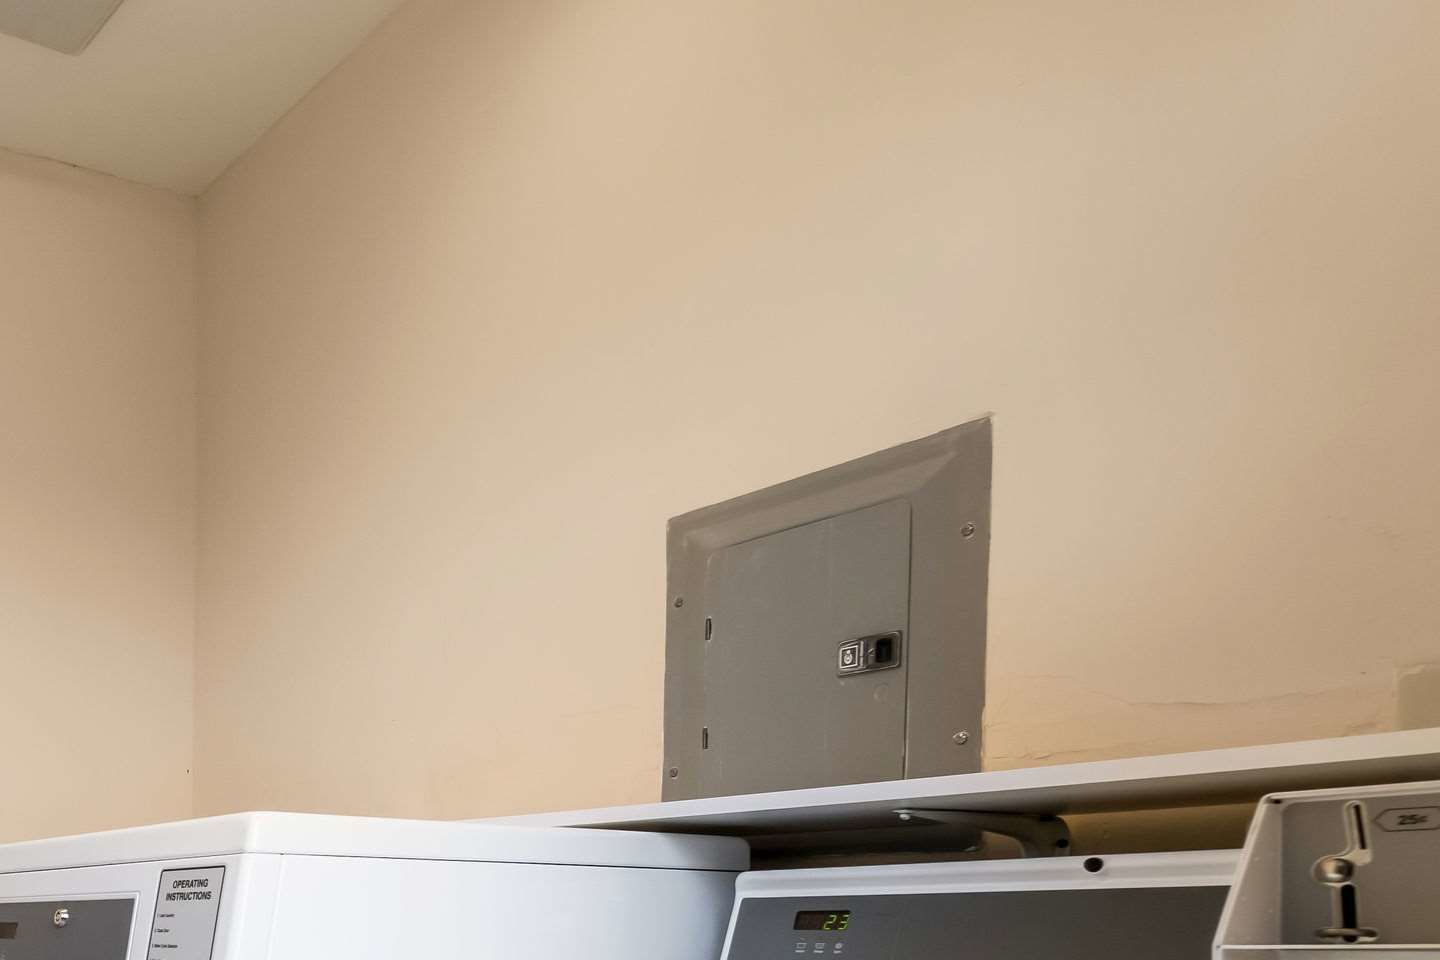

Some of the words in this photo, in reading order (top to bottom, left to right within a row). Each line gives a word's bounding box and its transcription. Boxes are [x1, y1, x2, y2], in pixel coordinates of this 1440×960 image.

[172, 878, 209, 889] OPERATING
[165, 891, 212, 902] INSTRUCTIONS
[822, 914, 850, 931] 23
